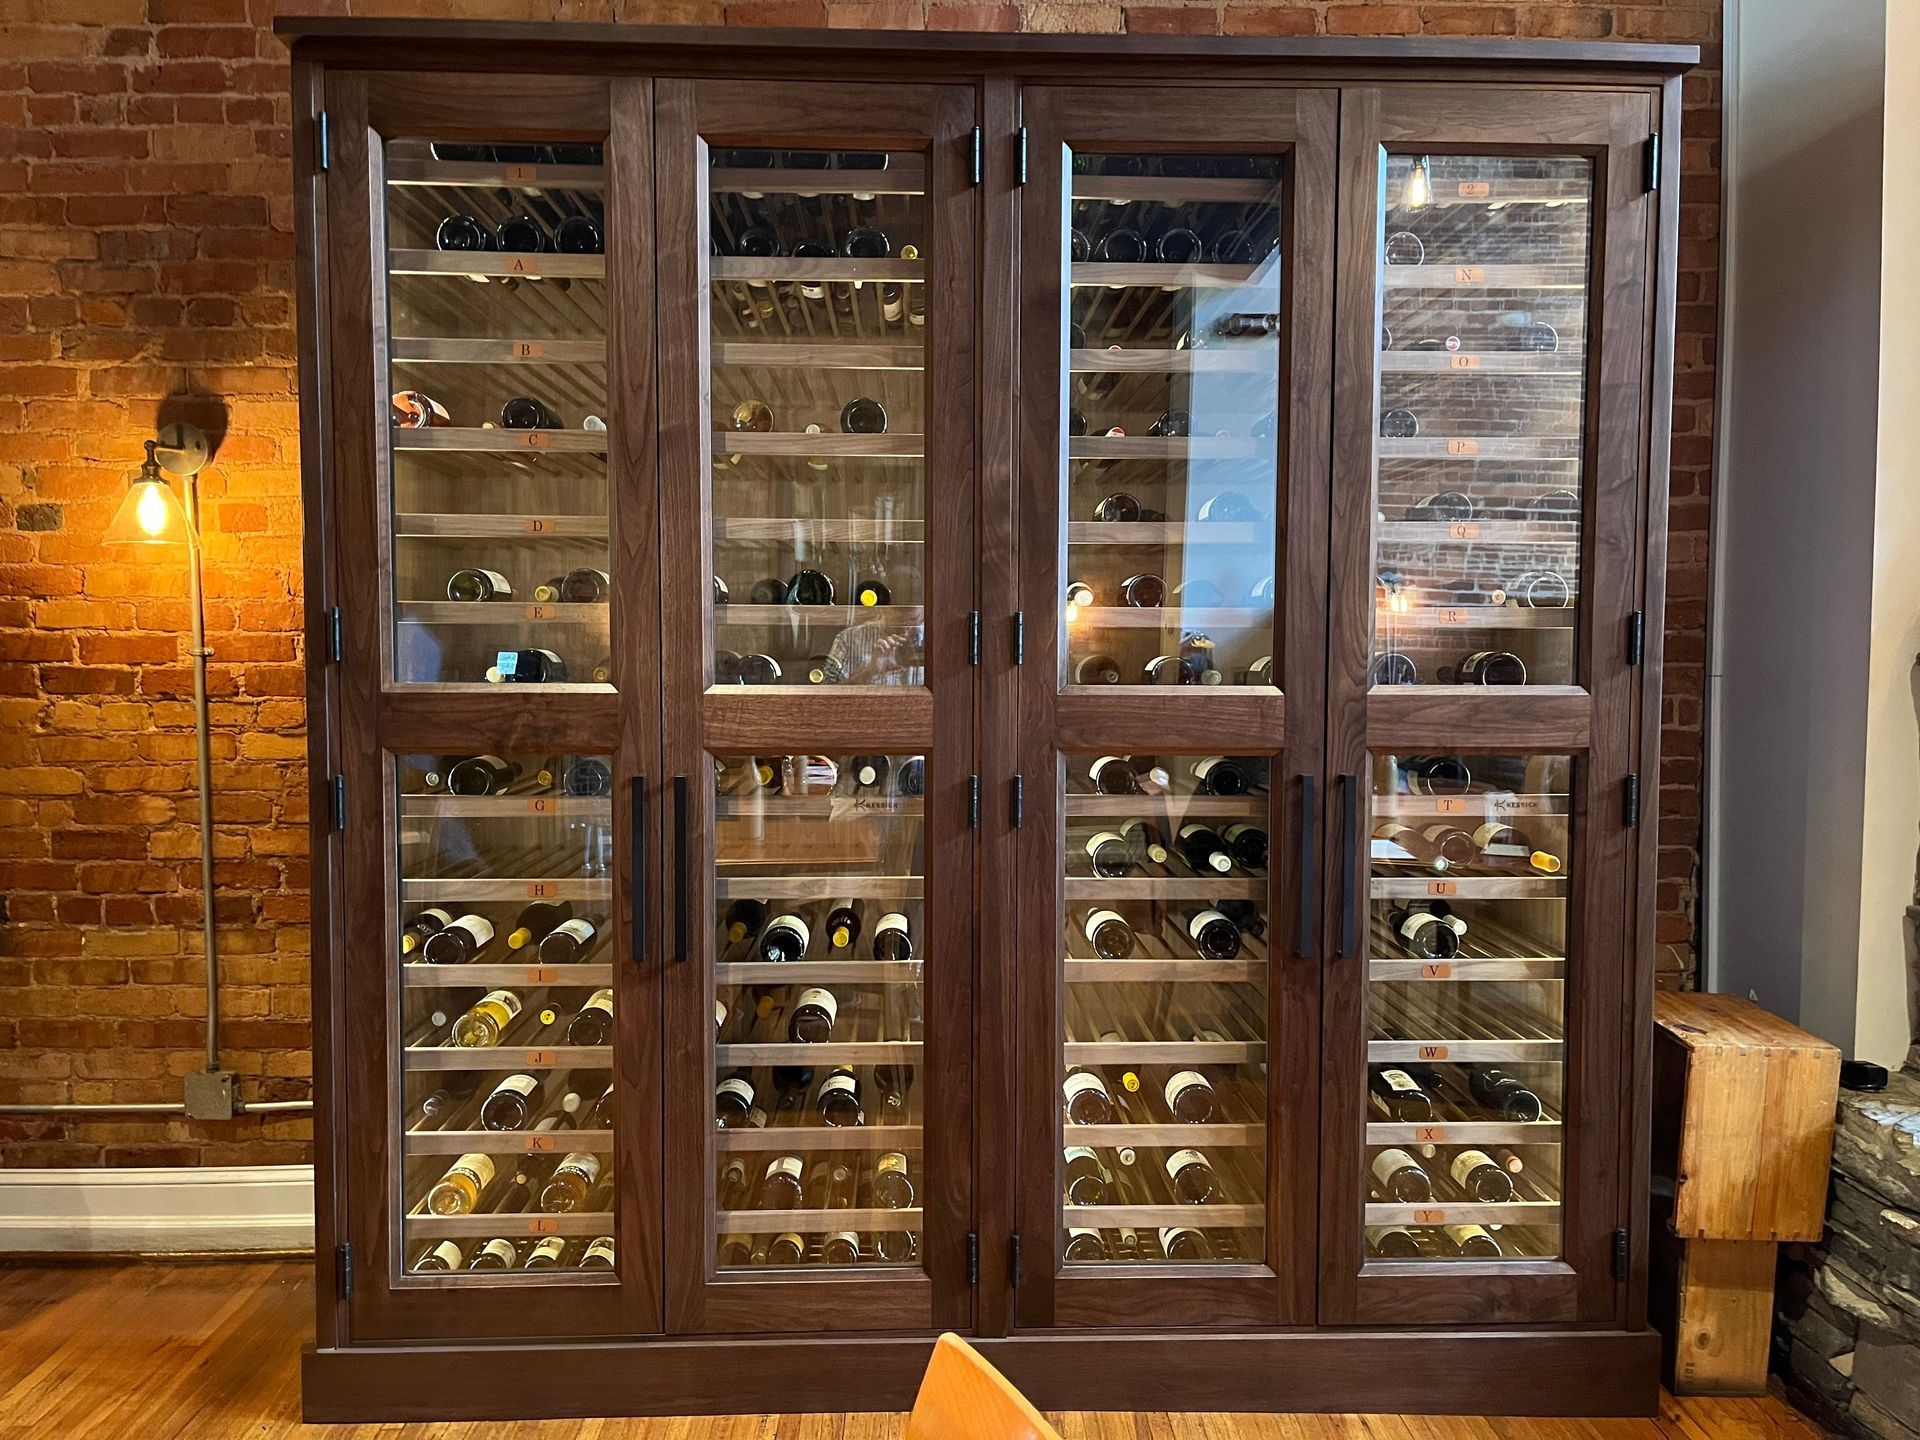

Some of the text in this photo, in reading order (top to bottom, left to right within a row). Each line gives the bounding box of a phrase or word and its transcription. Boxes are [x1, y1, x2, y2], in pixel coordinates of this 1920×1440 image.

[1466, 184, 1474, 195] 2
[514, 259, 524, 271] A
[1461, 269, 1471, 280] N
[521, 343, 530, 355] B
[1459, 356, 1468, 367] O
[528, 433, 538, 445] C
[1457, 441, 1466, 453] P
[533, 520, 543, 532] D
[1456, 526, 1466, 538] Q
[534, 607, 543, 618] E
[1448, 610, 1457, 622] R
[535, 800, 545, 811] G
[1443, 799, 1453, 811] T
[534, 884, 544, 896] H
[1436, 882, 1446, 894] U
[1429, 965, 1439, 976] V
[1424, 1046, 1438, 1057] W
[535, 1052, 542, 1063] J
[1424, 1128, 1433, 1139] X
[533, 1137, 542, 1148] K
[1422, 1210, 1432, 1221] Y
[537, 1220, 546, 1231] L
